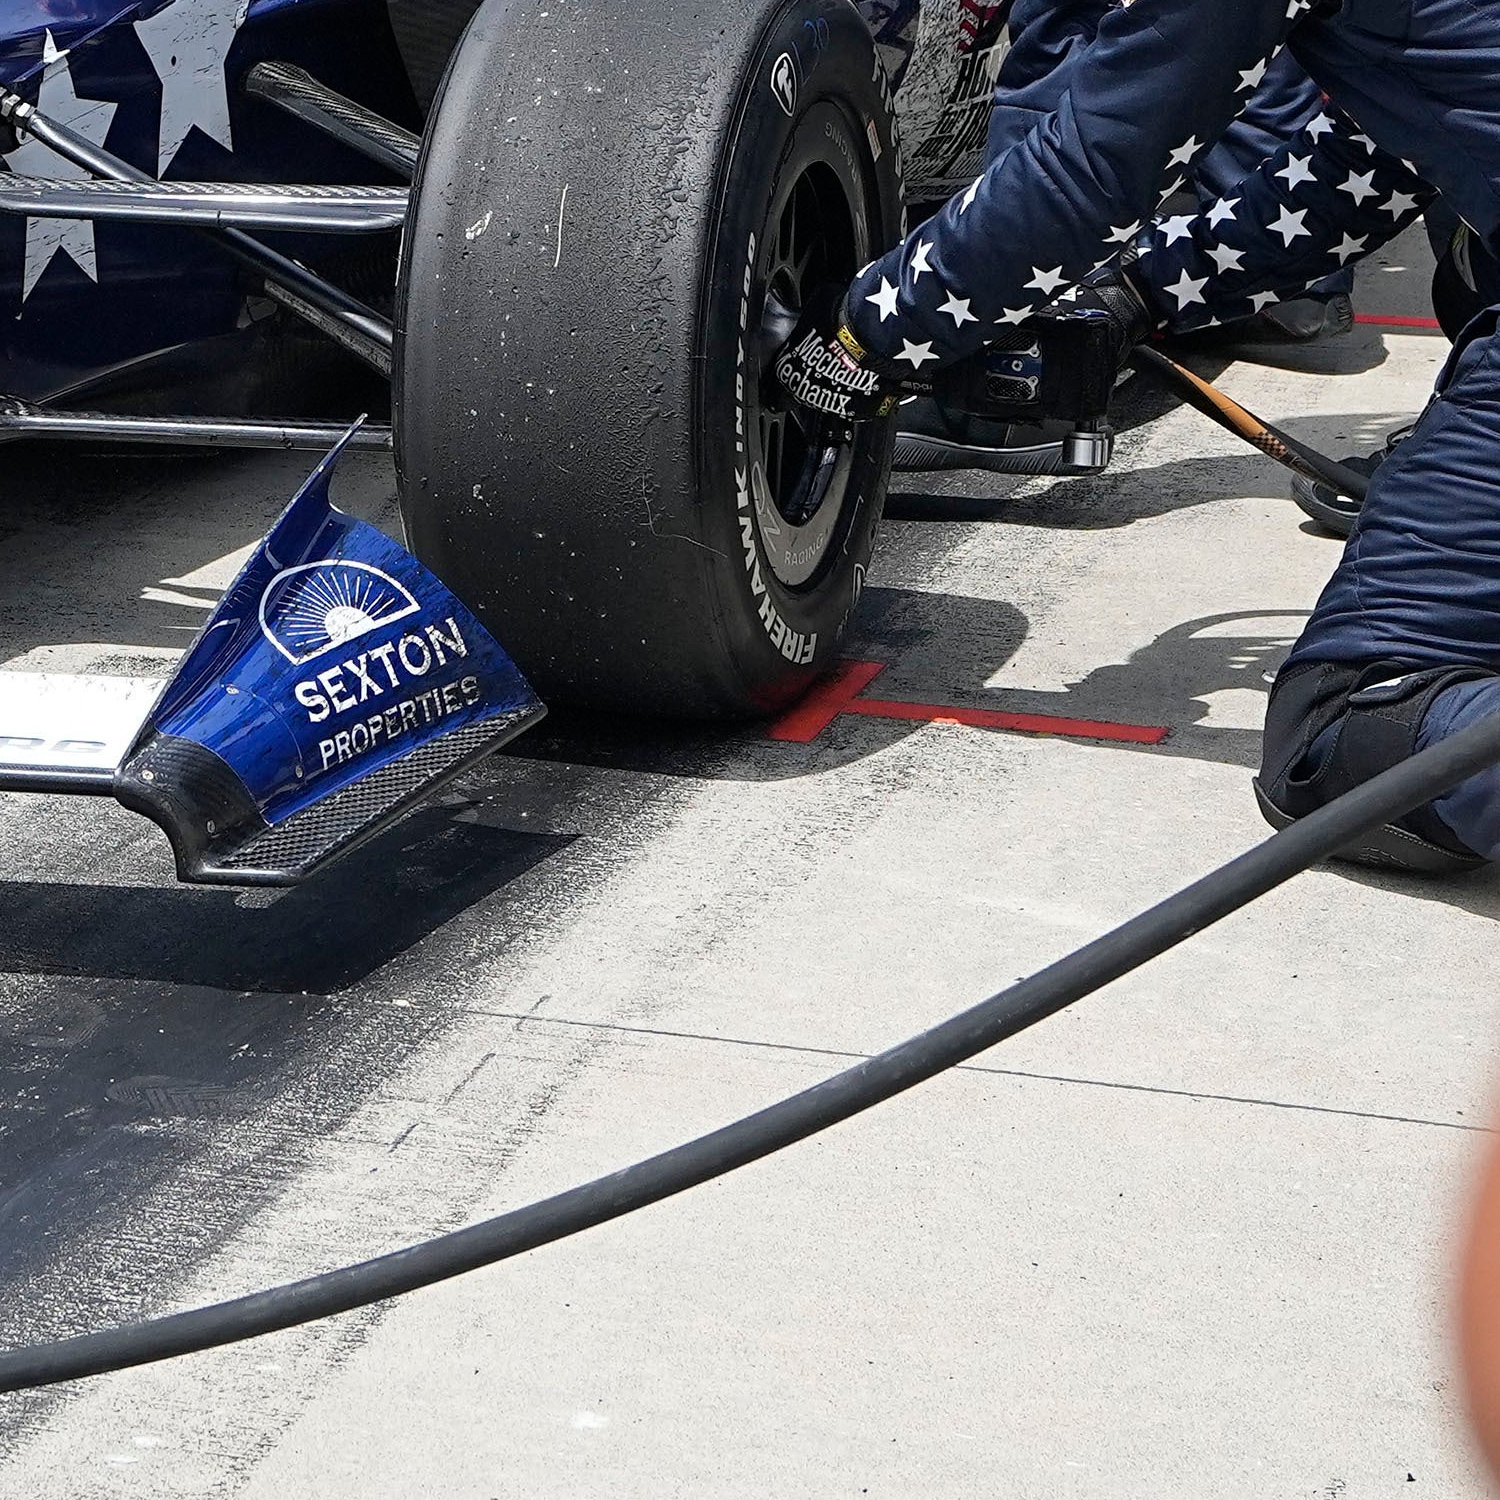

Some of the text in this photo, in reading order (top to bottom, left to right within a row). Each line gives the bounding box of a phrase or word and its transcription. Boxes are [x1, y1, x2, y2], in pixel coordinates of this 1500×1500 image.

[794, 327, 880, 394] Mechanix
[734, 464, 818, 665] FIREHAWK
[783, 532, 826, 566] RACING
[293, 616, 471, 723] SEXTON
[318, 674, 482, 771] PROPERTIES
